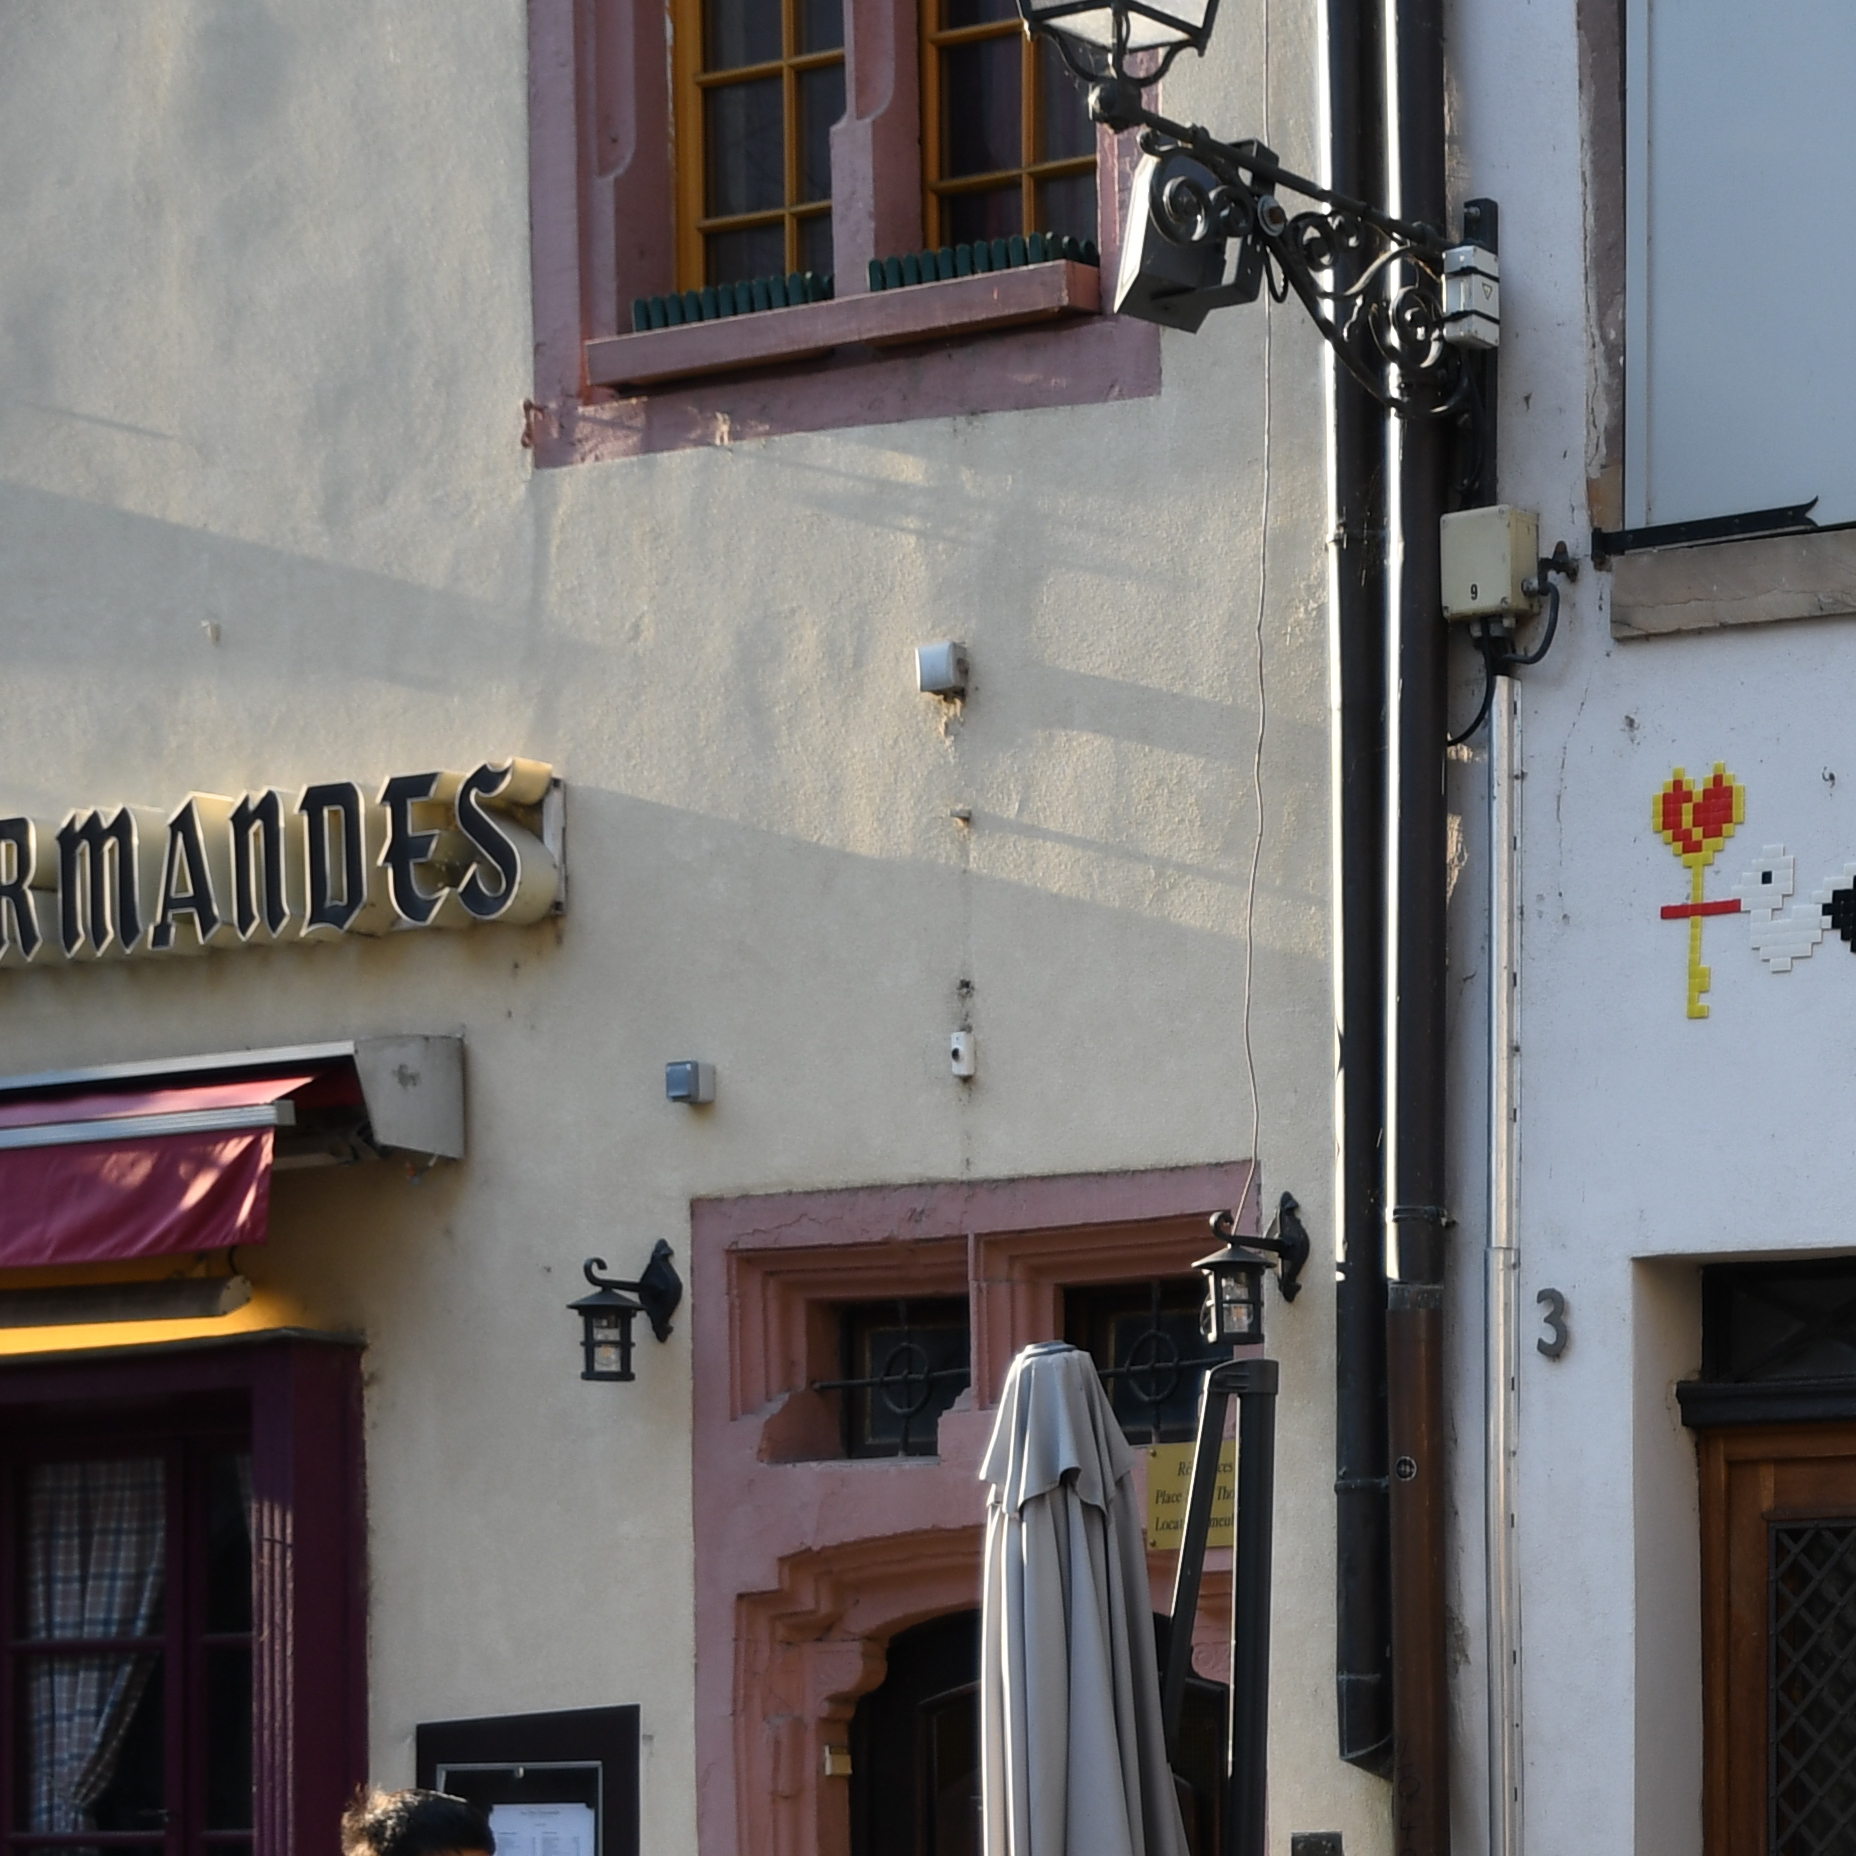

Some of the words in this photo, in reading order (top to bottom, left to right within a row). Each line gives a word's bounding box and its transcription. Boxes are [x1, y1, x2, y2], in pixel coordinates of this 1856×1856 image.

[1470, 583, 1478, 601] 9
[1536, 1288, 1568, 1360] 3
[1155, 1488, 1183, 1505] Place
